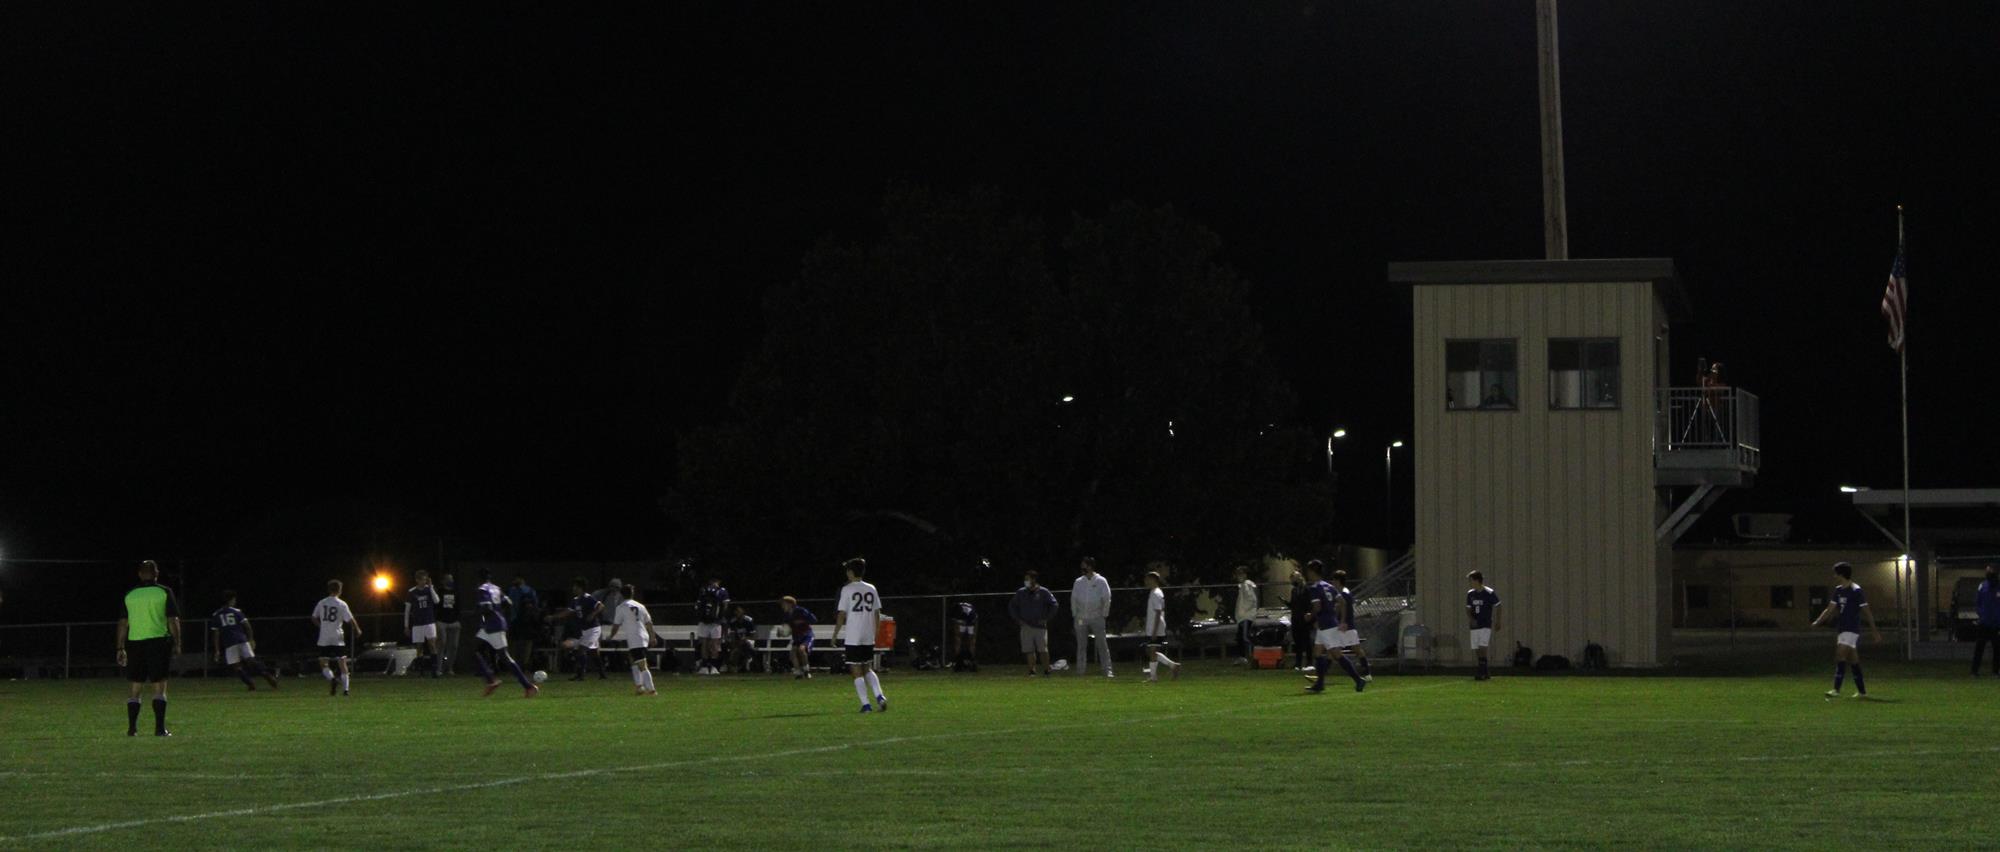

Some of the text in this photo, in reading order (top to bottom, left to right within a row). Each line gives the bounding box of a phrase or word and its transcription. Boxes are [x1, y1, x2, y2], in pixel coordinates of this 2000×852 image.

[852, 592, 875, 612] 29
[219, 612, 236, 627] 16
[322, 605, 338, 622] 18
